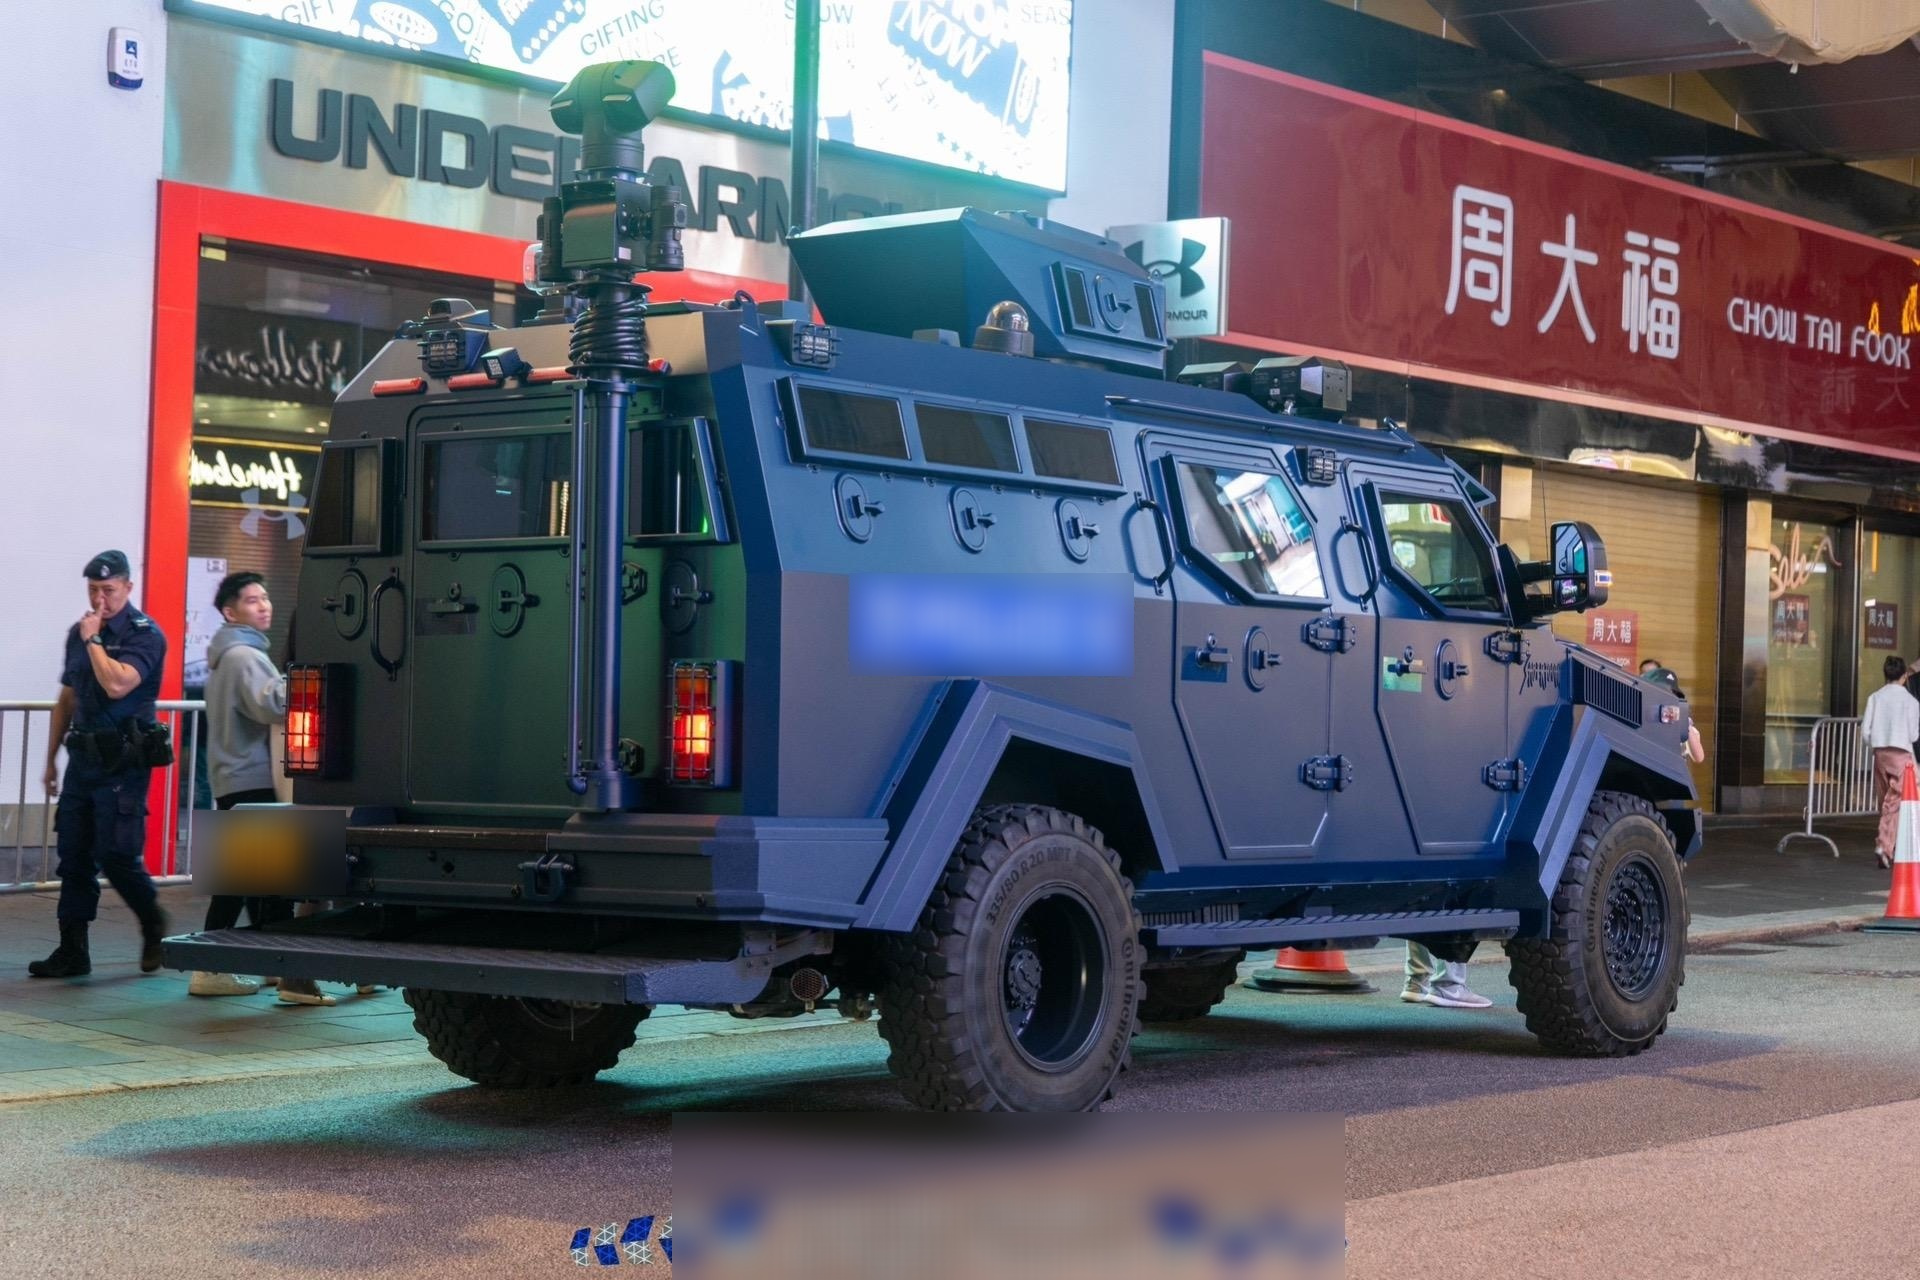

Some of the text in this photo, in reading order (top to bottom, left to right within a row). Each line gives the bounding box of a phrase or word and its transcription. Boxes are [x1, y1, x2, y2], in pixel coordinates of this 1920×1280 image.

[580, 2, 665, 56] GIFTING
[784, 0, 853, 24] SOW
[895, 0, 991, 79] NOW
[1445, 184, 1681, 360] 周大福
[1165, 309, 1208, 321] RMOUR
[1726, 297, 1911, 369] CHOW TAI FOOK
[1592, 617, 1632, 643] 周大福
[1108, 936, 1135, 1063] Continental
